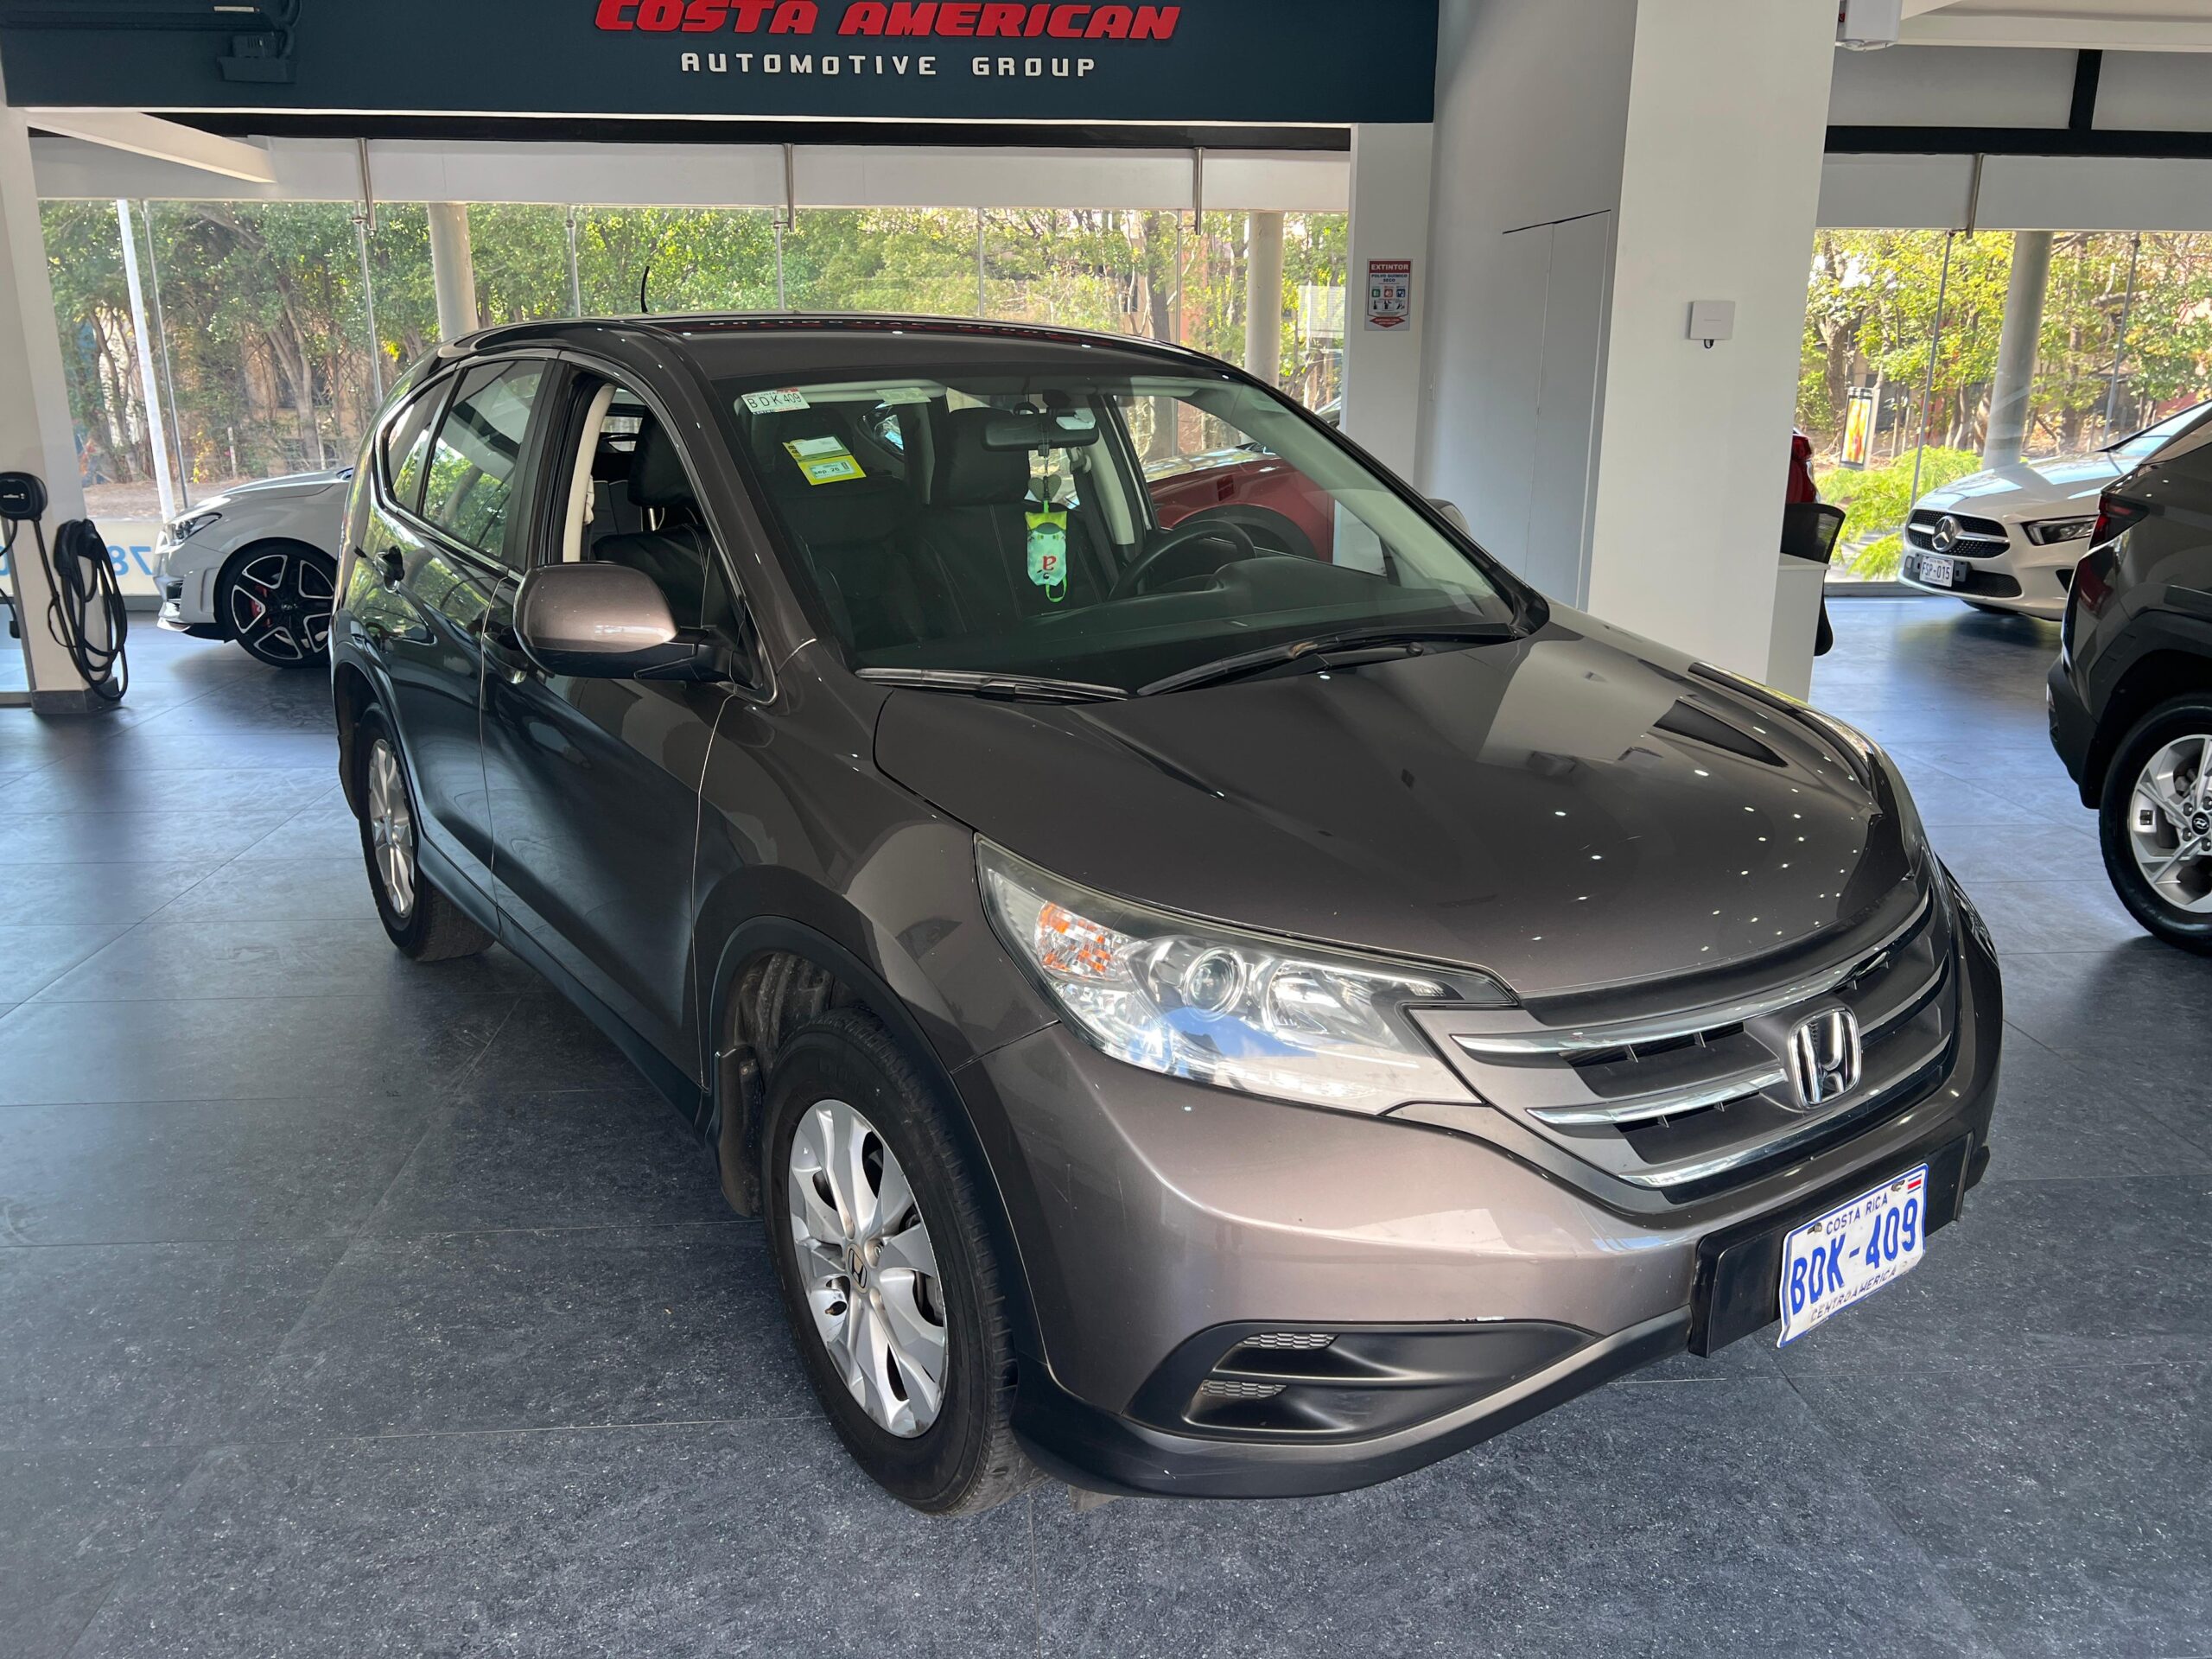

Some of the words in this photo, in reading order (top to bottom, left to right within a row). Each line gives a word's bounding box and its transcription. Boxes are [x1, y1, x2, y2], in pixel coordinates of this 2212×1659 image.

[595, 0, 818, 35] COSTA
[836, 0, 1182, 41] AMERICAN
[681, 52, 938, 76] AUTOMOTIVE
[972, 56, 1096, 78] GROUP
[1921, 562, 1951, 580] FSP-015
[1826, 1207, 1861, 1236] COSTA
[1865, 1192, 1889, 1215] RICA
[1789, 1198, 1918, 1316] BDK-409
[1810, 1266, 1897, 1322] CENTROAMERICA
